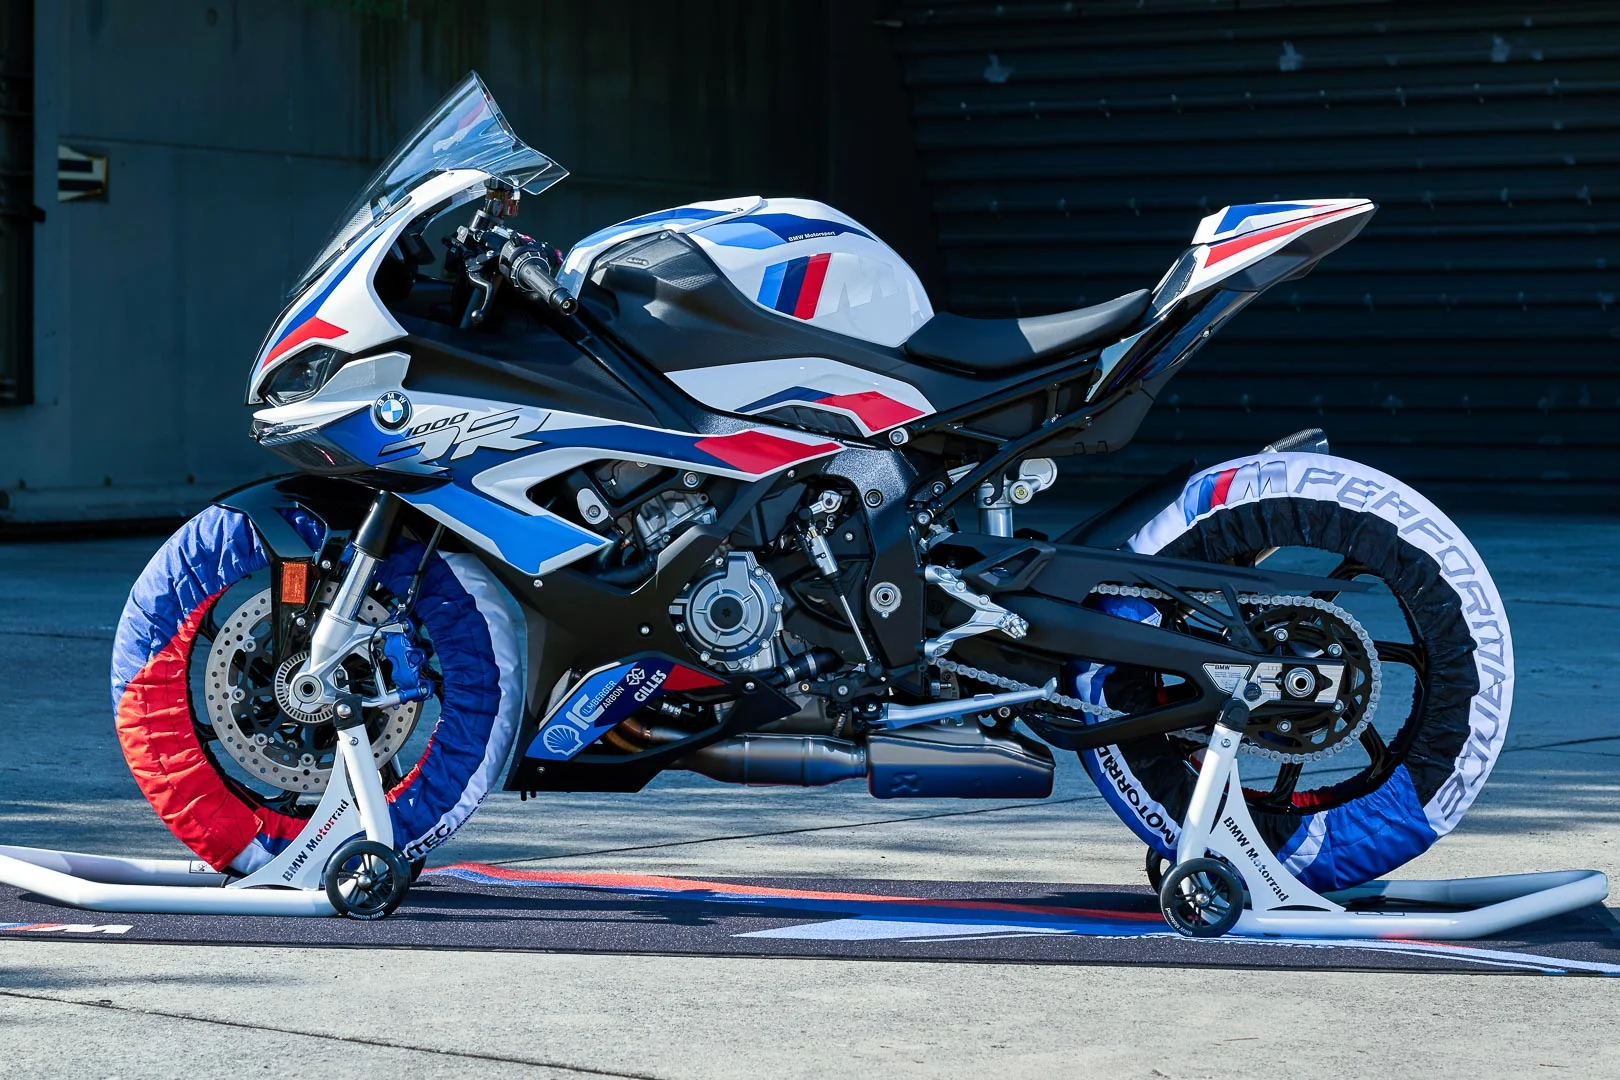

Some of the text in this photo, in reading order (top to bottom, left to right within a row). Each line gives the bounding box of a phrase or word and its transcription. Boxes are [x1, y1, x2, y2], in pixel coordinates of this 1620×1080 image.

[788, 231, 836, 242] BMW Motorsport
[378, 390, 407, 407] BMW
[404, 412, 469, 438] 1000
[582, 680, 617, 715] ILMBERGER
[634, 669, 667, 702] GILLES
[282, 799, 350, 882] BMW Motorrad
[1223, 816, 1290, 902] BMW Motorrad
